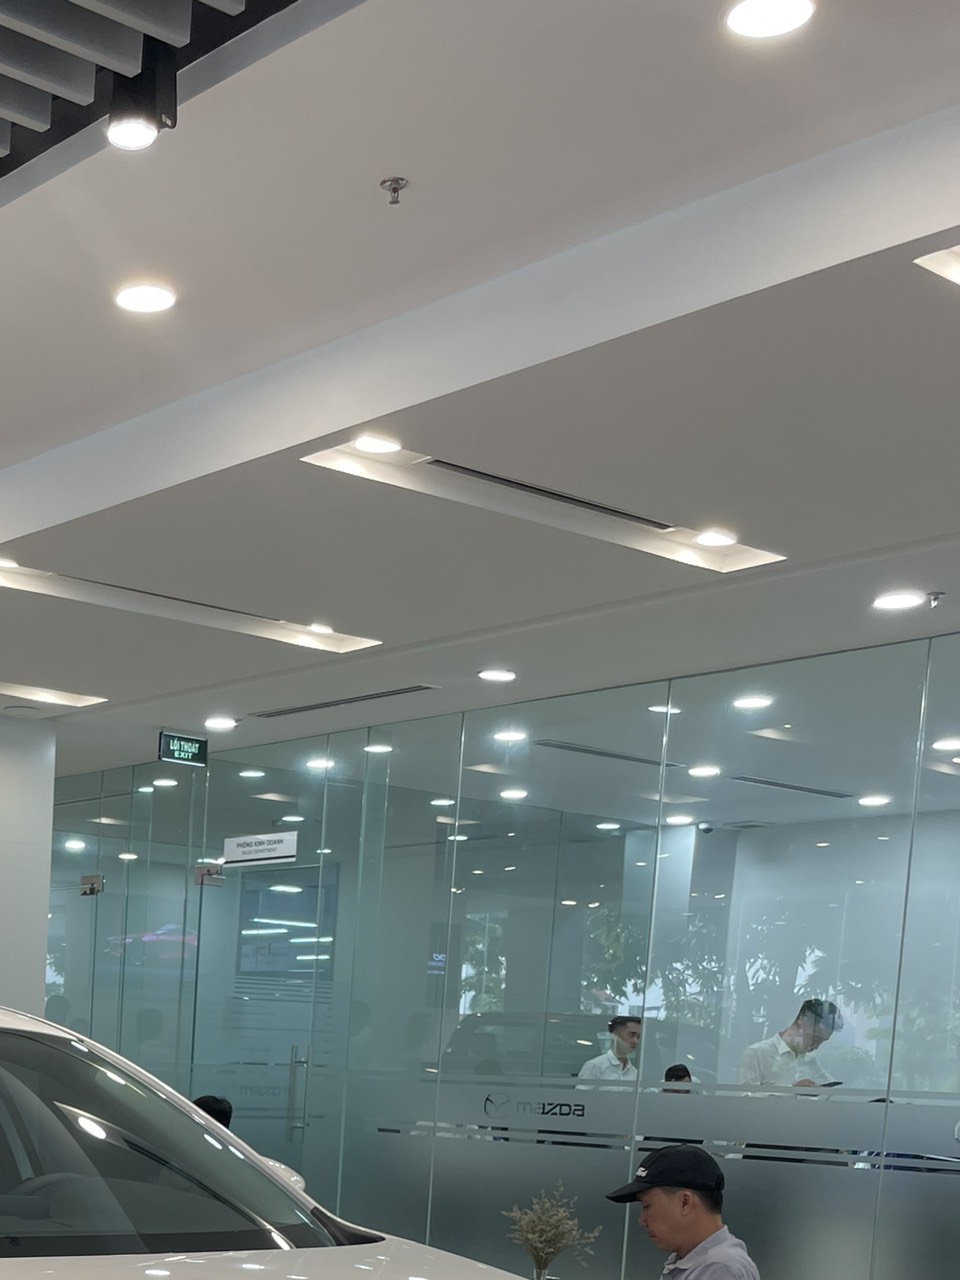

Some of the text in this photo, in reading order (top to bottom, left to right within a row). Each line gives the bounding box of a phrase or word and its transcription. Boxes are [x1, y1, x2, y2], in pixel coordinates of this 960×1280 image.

[170, 737, 199, 754] LỐI THOÁT
[174, 751, 193, 759] EXIT
